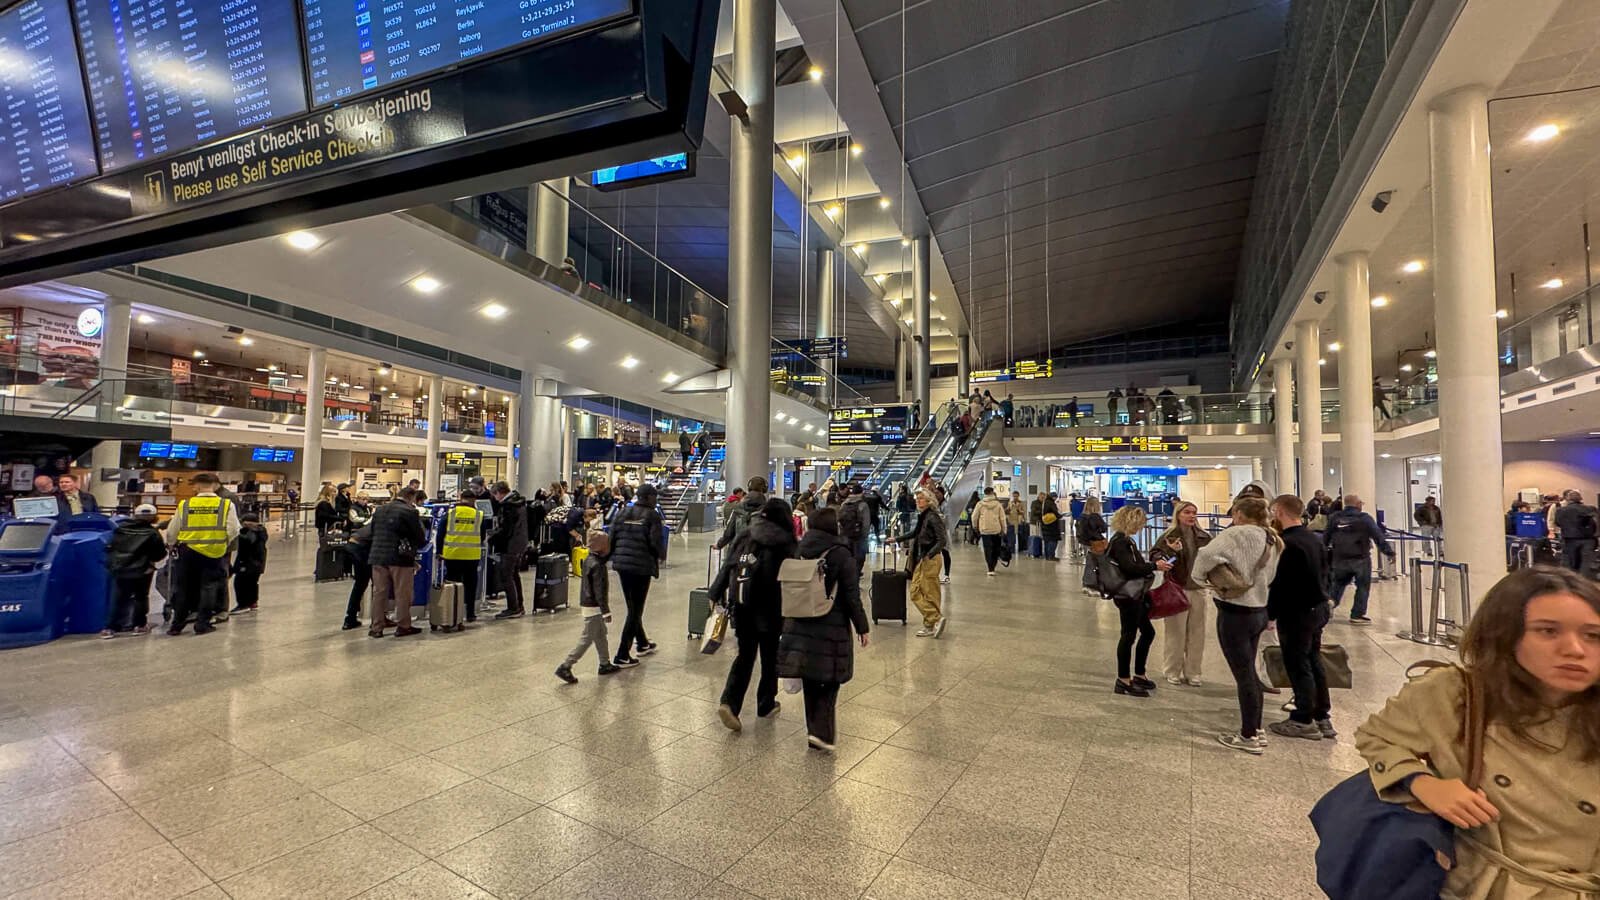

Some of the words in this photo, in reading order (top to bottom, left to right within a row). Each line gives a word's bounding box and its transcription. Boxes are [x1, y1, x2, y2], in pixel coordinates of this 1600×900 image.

[521, 0, 575, 23] 1-3,21-29,31-34
[522, 30, 532, 38] Go
[542, 18, 568, 32] Terminal
[570, 16, 576, 24] 2
[459, 30, 481, 44] Aalborg
[171, 156, 205, 180] Benyt
[208, 141, 256, 169] venligst
[260, 122, 320, 152] Check-in
[174, 181, 213, 202] Please
[216, 173, 239, 190] use
[242, 162, 266, 184] Self
[272, 150, 324, 176] Service
[328, 127, 394, 158] Check-in
[54, 321, 70, 330] only
[54, 336, 72, 344] NEW
[1, 604, 22, 612] SAS
